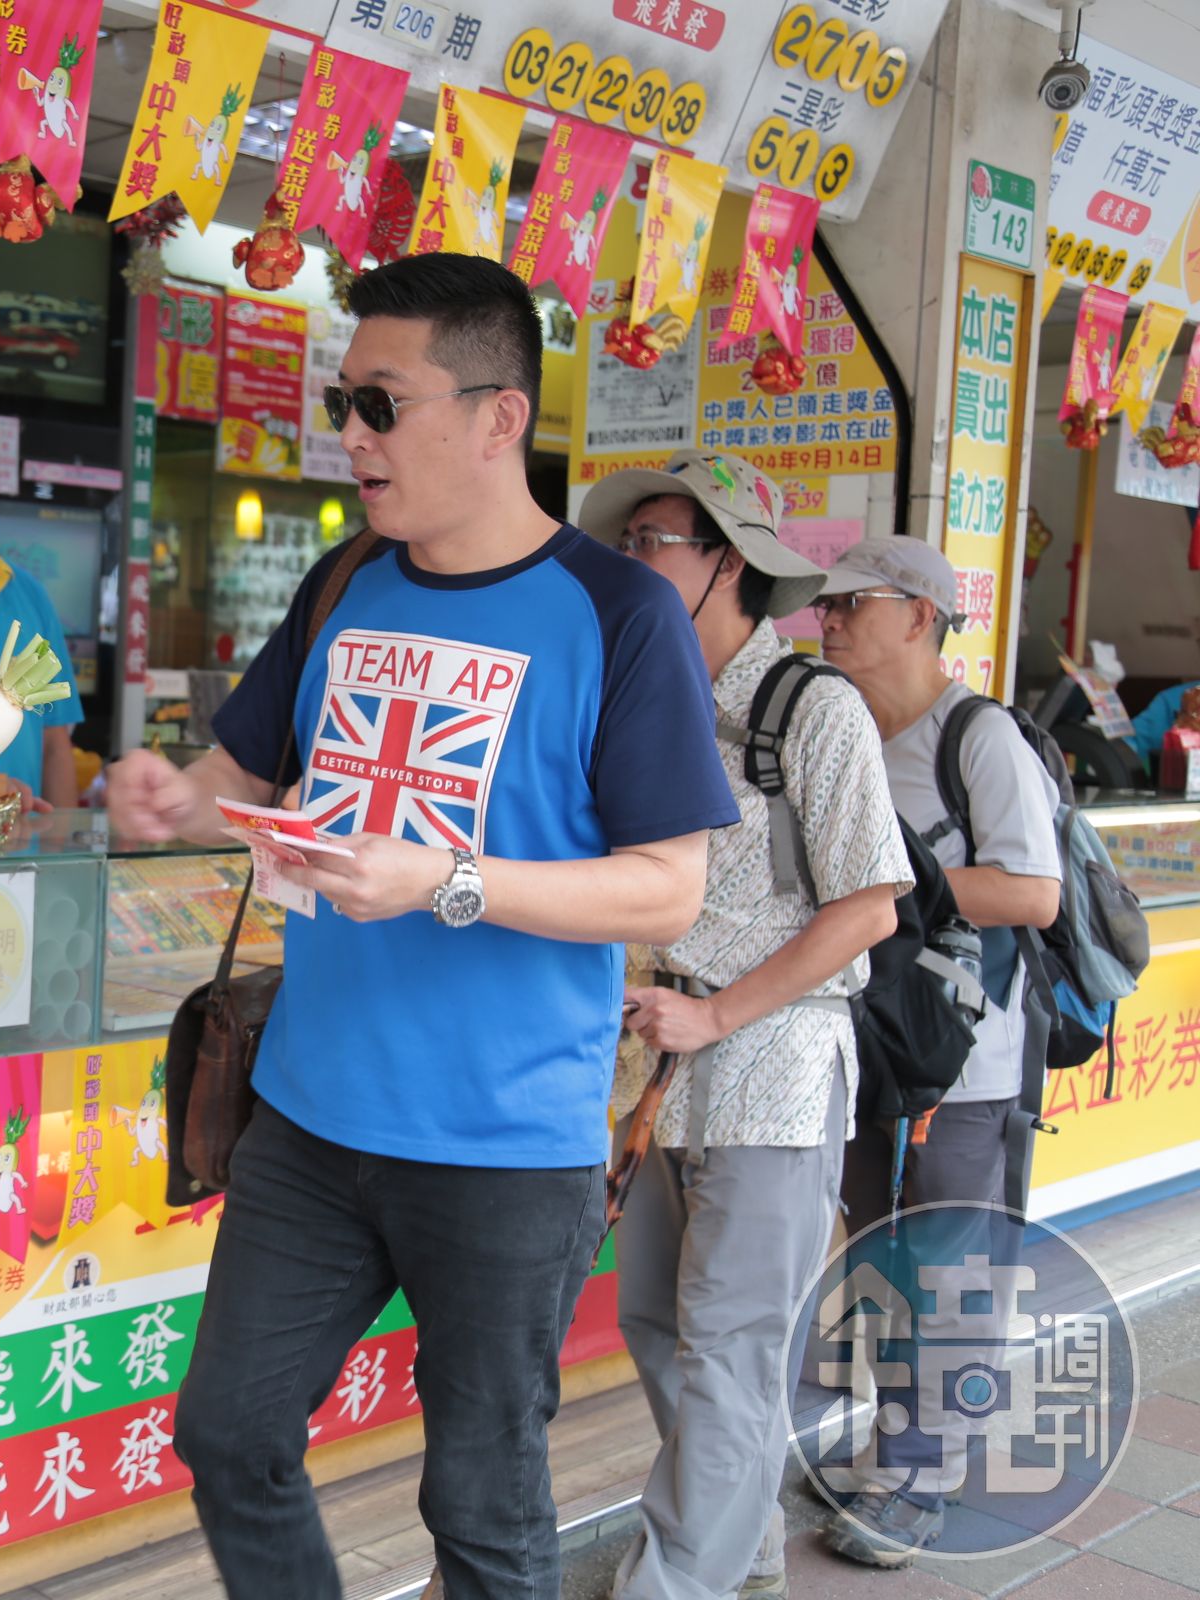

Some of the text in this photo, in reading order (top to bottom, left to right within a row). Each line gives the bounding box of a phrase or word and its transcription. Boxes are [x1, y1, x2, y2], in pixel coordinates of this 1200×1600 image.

[164, 2, 192, 84] 好彩頭
[632, 0, 709, 43] 飛來發
[314, 50, 341, 140] 買彩券
[511, 40, 701, 135] 03 21 22 30 38
[773, 81, 845, 133] 三星彩
[127, 81, 177, 200] 中大獎
[418, 158, 455, 255] 中大獎
[511, 192, 554, 287] 送菜頭
[992, 209, 1027, 253] 143
[638, 216, 665, 311] 中大獎
[959, 288, 1017, 365] 本店
[702, 418, 892, 448] 中獎彩券影本在此
[703, 389, 896, 423] 中獎人已領走獎金
[953, 370, 1008, 444] 賣出
[947, 471, 1006, 535] 威力彩
[338, 641, 514, 702] TEAM AP
[319, 754, 464, 794] BETTER NEVER STOPS
[84, 1055, 102, 1122] 好彩頭
[66, 1125, 102, 1229] 中大獎
[43, 1287, 118, 1316] 財政部關心您
[336, 1347, 388, 1425] 彩
